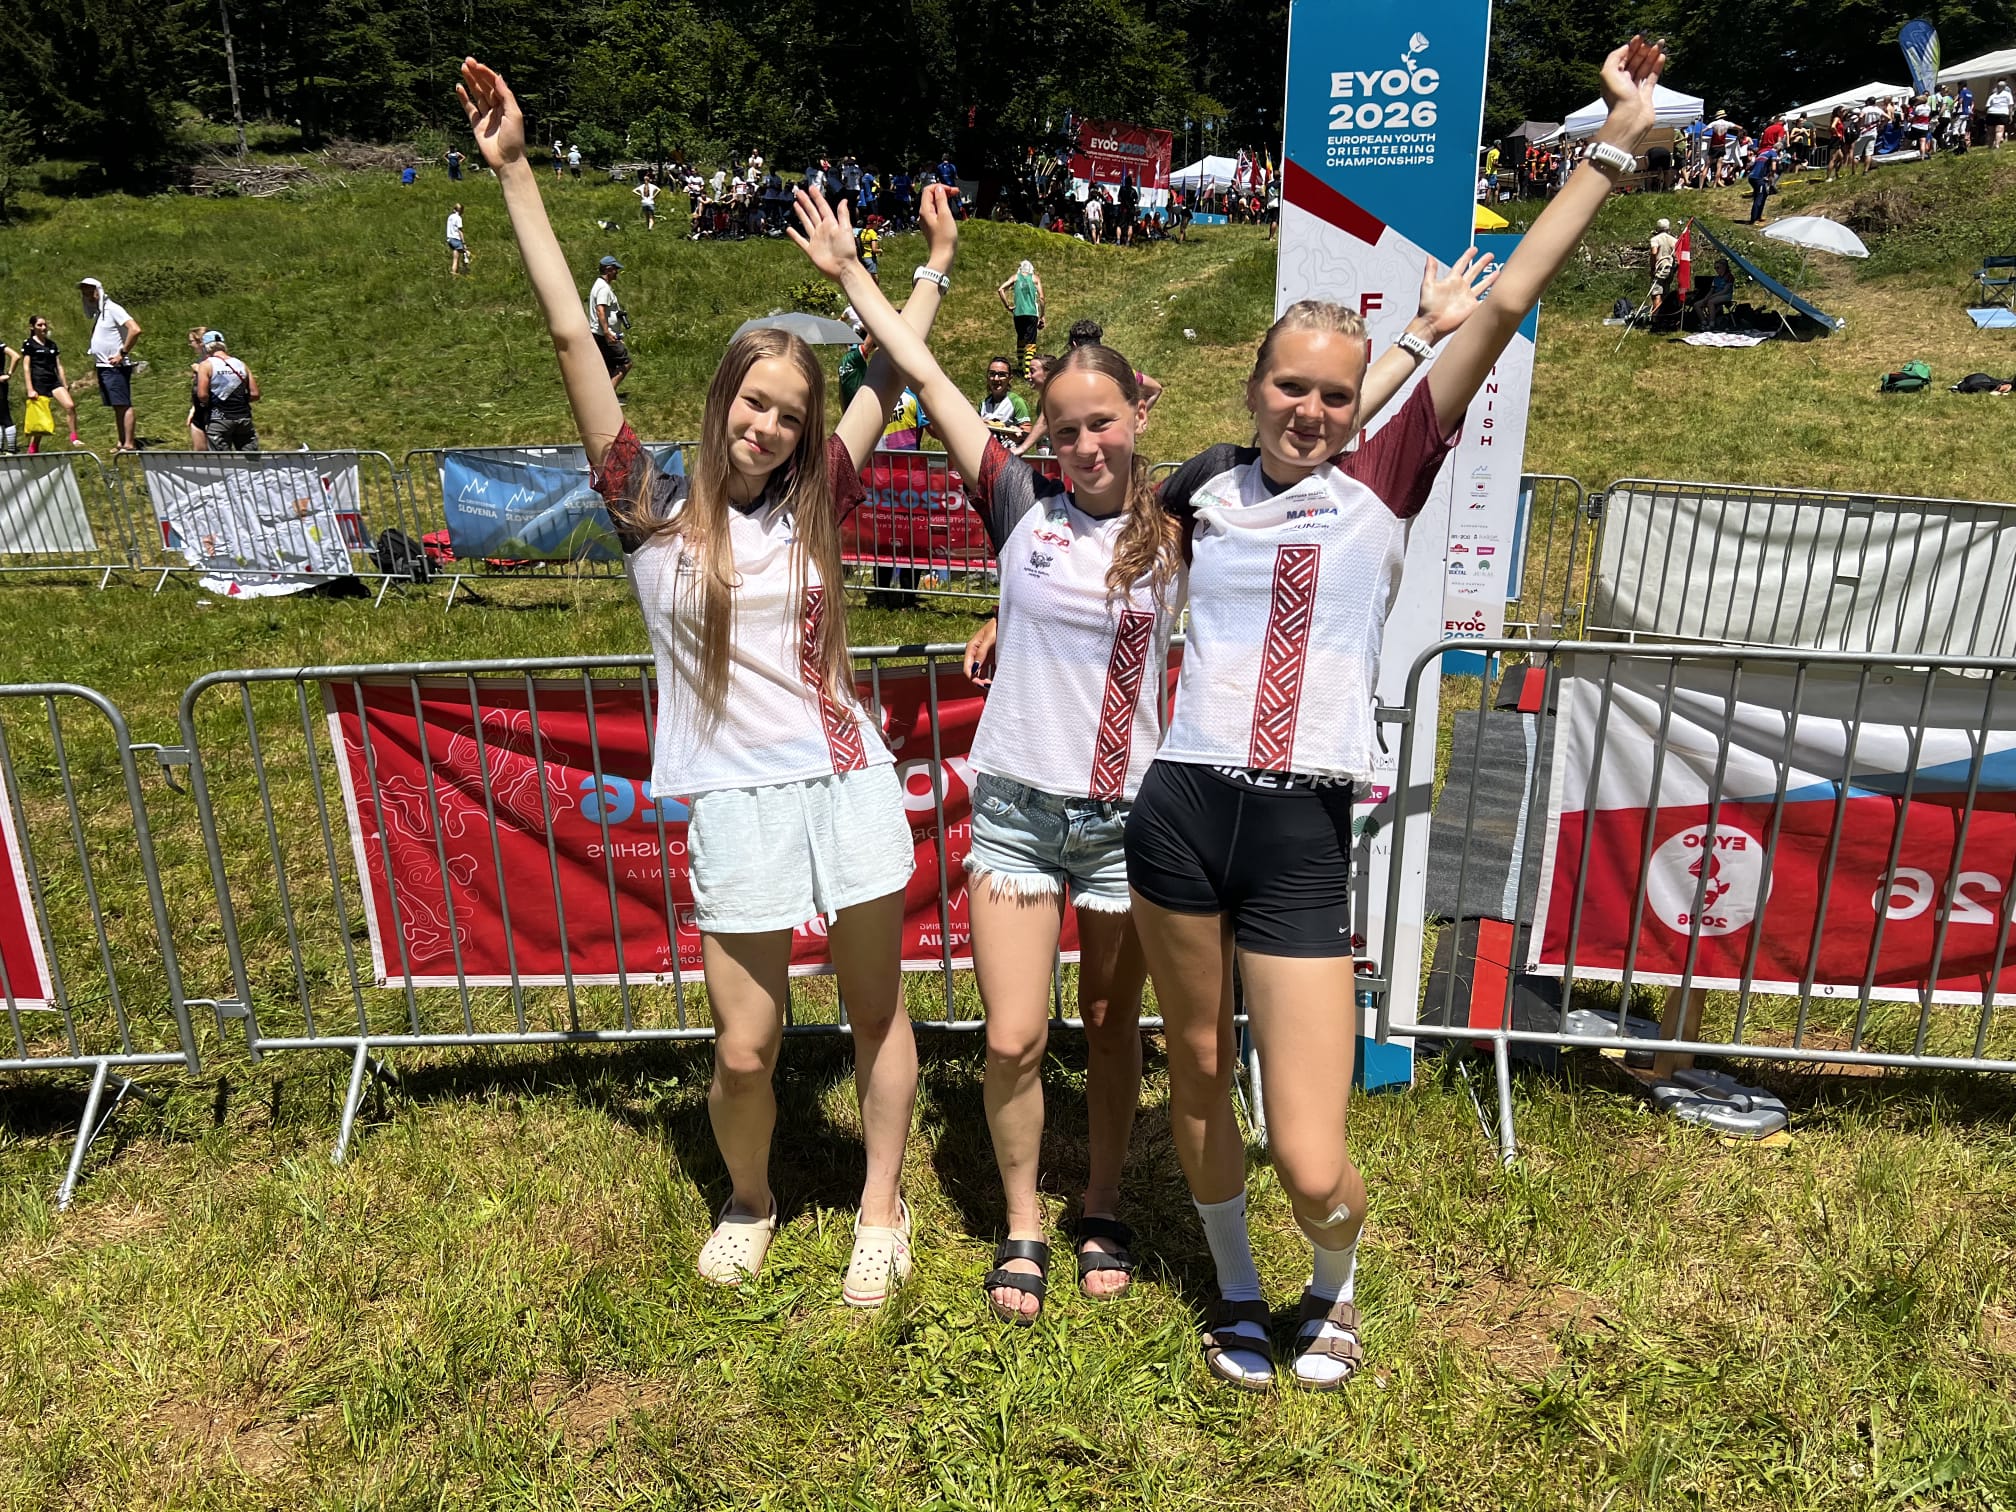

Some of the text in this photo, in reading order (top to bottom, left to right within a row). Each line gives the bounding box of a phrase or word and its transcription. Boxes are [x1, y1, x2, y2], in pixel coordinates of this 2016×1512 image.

[1330, 68, 1440, 98] EYOC
[1328, 101, 1437, 130] 2026
[1090, 137, 1119, 151] EYOC
[1328, 133, 1436, 145] EUROPEAN YOUTH
[1327, 144, 1435, 156] ORIENTEERING
[1326, 155, 1434, 167] CHAMPIONSHIPS
[458, 503, 498, 519] SLOVENIA
[1444, 621, 1486, 631] EYOC
